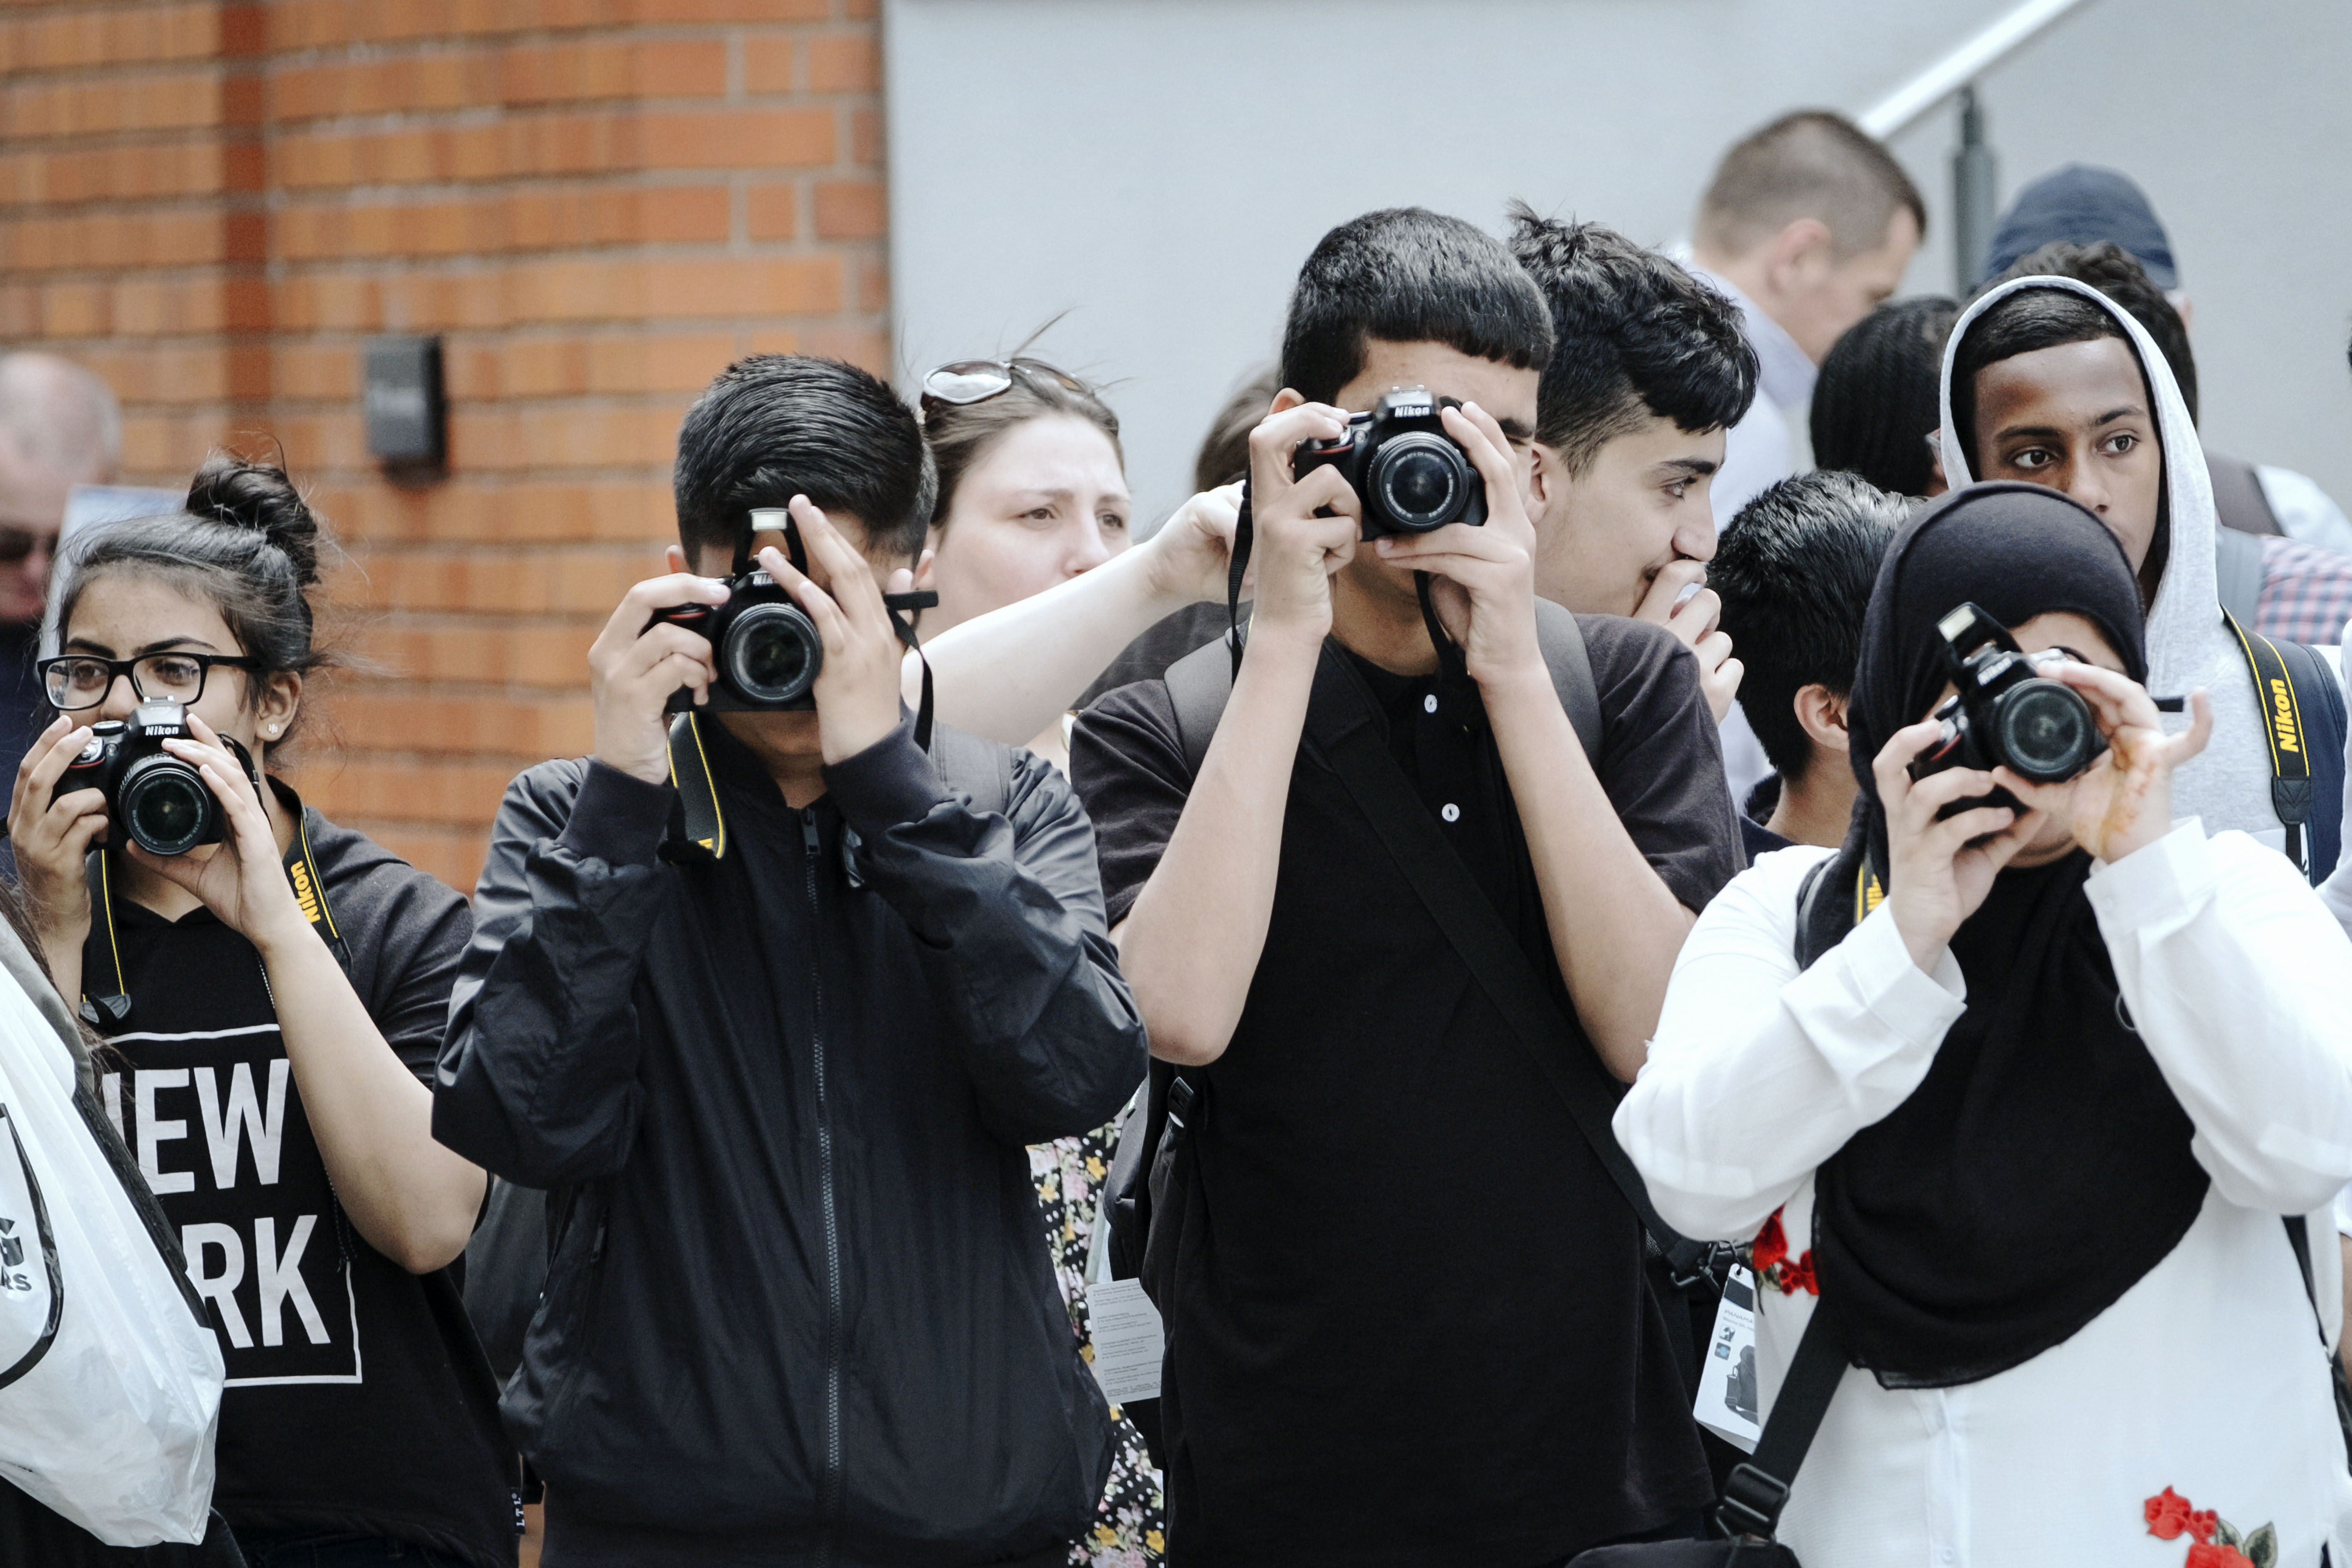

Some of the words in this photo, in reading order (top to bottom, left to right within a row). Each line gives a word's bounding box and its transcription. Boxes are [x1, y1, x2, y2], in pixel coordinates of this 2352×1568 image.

[1394, 406, 1430, 417] Nikon
[145, 726, 179, 736] Nikon
[2270, 679, 2299, 752] Nikon
[291, 860, 321, 923] Nikon
